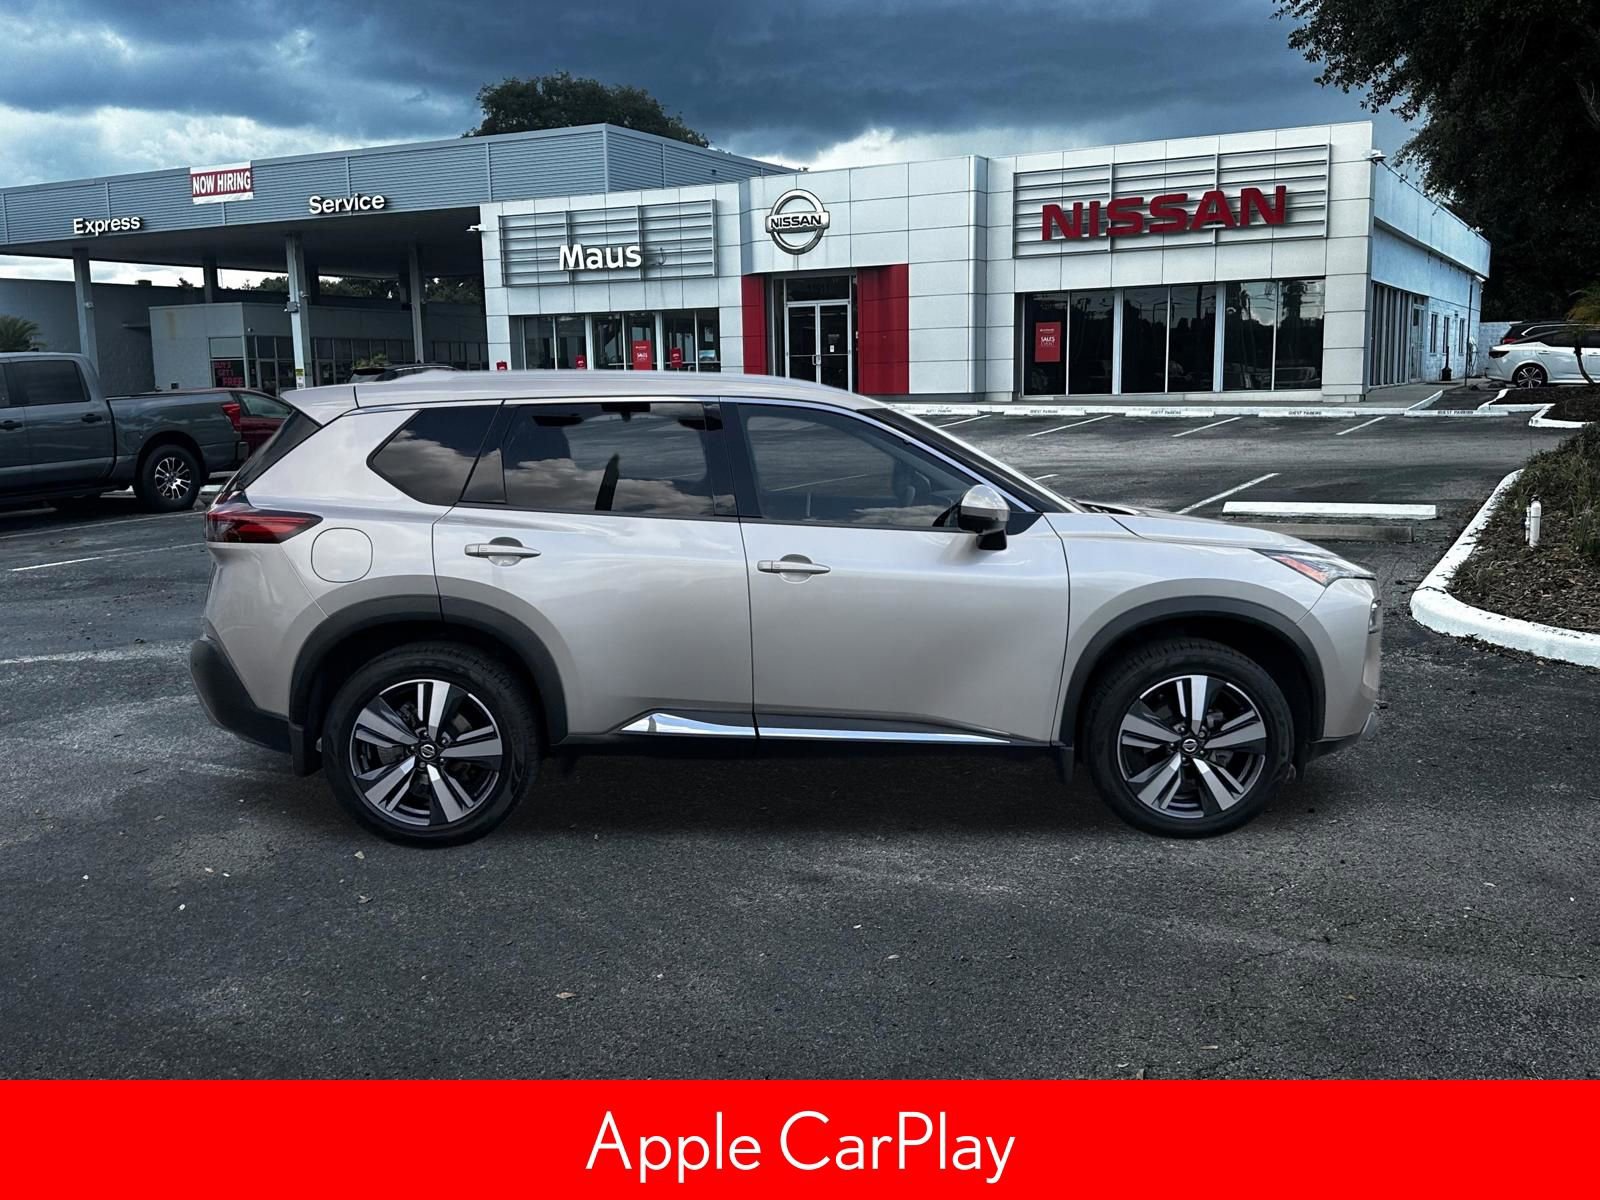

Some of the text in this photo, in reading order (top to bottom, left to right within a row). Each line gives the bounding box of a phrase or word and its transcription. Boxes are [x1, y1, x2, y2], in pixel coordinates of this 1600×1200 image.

[192, 171, 251, 195] NOW HIRING
[309, 192, 385, 214] Service
[1042, 185, 1287, 241] NISSAN
[73, 216, 141, 237] Express
[770, 214, 822, 229] NISSAN
[559, 243, 642, 271] Maus
[223, 377, 243, 386] FREE
